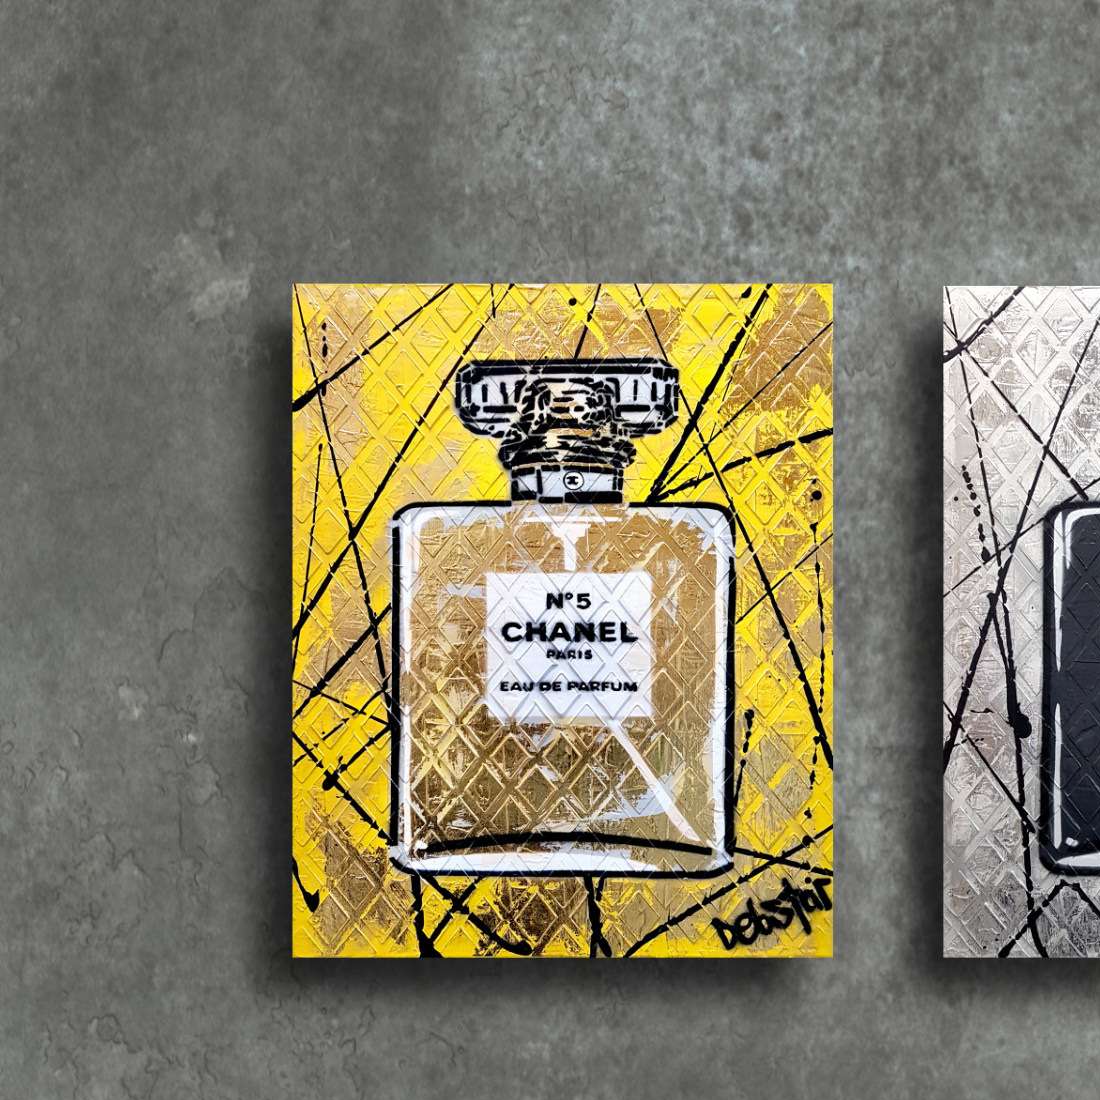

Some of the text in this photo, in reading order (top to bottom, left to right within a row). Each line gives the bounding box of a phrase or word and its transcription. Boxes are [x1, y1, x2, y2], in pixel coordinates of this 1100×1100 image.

[501, 621, 639, 643] CHANEL
[546, 650, 593, 660] PARIS
[500, 681, 638, 692] EAU DE PARFUM
